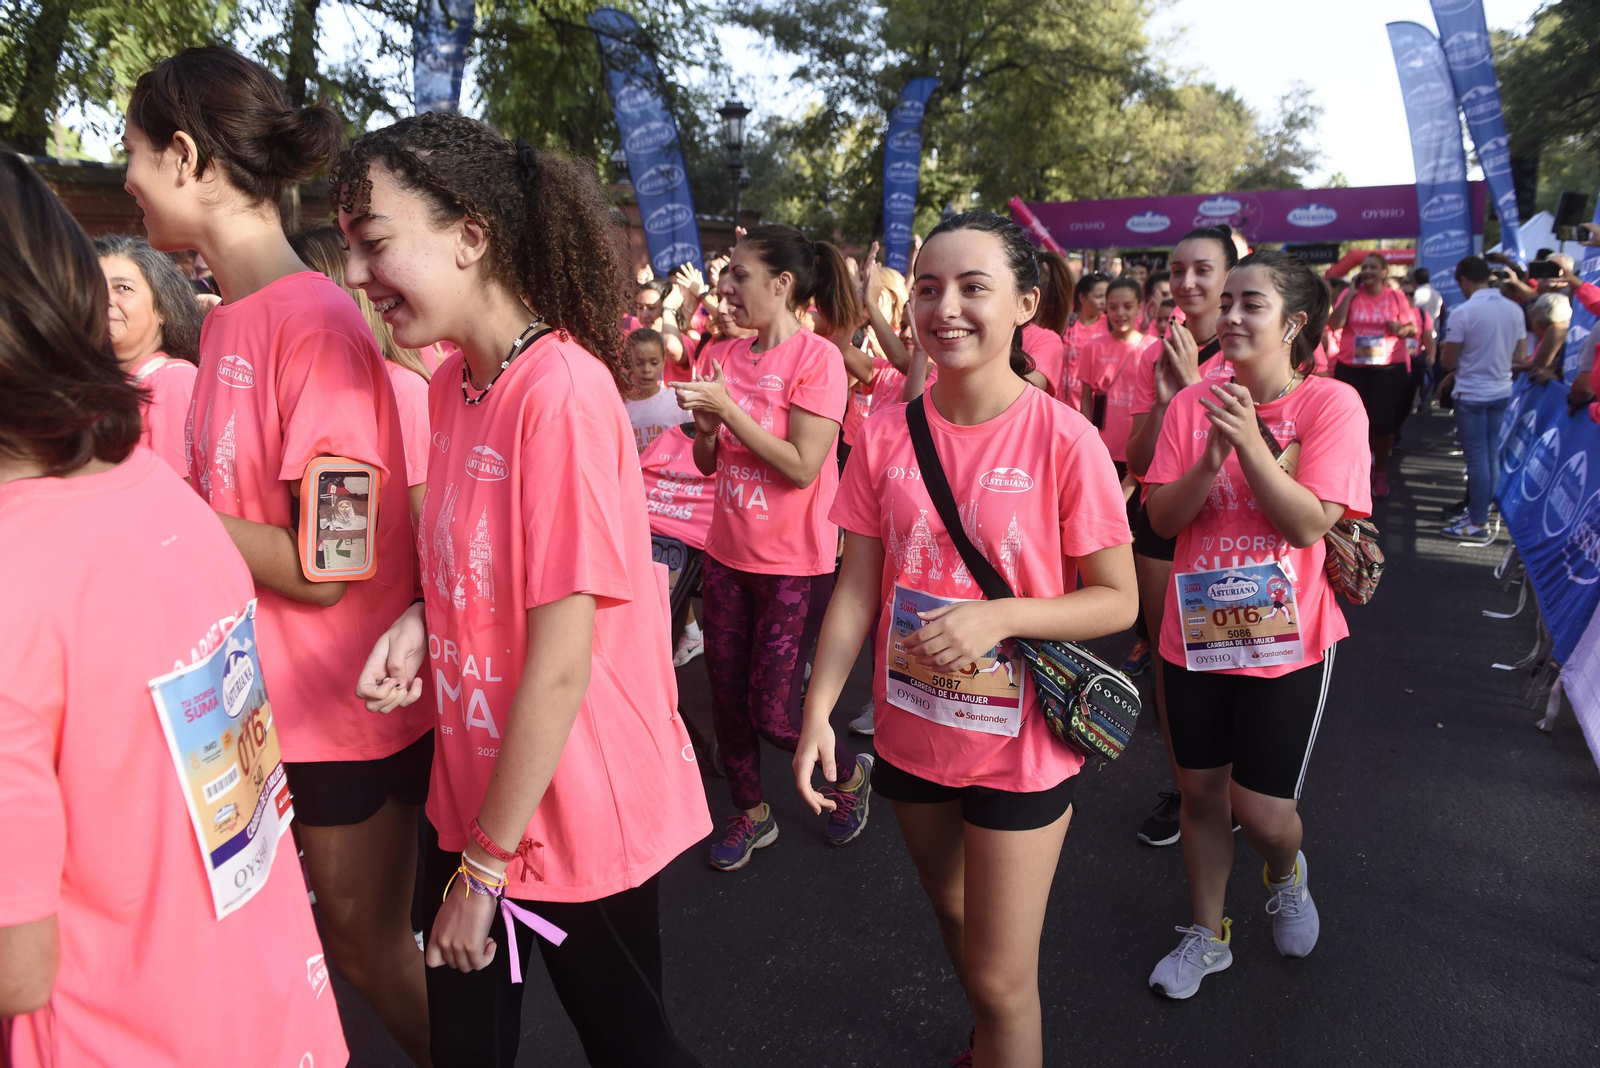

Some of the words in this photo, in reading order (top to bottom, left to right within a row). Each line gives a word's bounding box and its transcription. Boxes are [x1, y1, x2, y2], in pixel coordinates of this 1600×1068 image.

[1362, 208, 1405, 219] OYSHO
[1070, 221, 1105, 232] OYSHO
[983, 475, 1029, 488] ASTURIANA
[1201, 536, 1215, 551] TU
[1210, 586, 1256, 597] ASTURIANA
[900, 603, 918, 615] SUMA
[1212, 605, 1260, 627] 016
[1228, 629, 1251, 639] 5086
[1206, 640, 1234, 649] CARRERA
[1253, 636, 1276, 645] MUJER
[1196, 653, 1231, 664] OYSHO
[1260, 649, 1294, 659] Santander
[932, 675, 961, 690] 5087
[910, 678, 936, 696] CARRERA
[938, 689, 948, 699] DE
[949, 691, 959, 700] LA
[961, 694, 988, 704] MUJER
[181, 700, 192, 709] TU
[897, 688, 931, 710] OYSHO
[184, 696, 219, 723] SUMA
[965, 711, 1008, 724] Santander
[237, 708, 265, 777] 016
[234, 836, 267, 888] OYSHO
